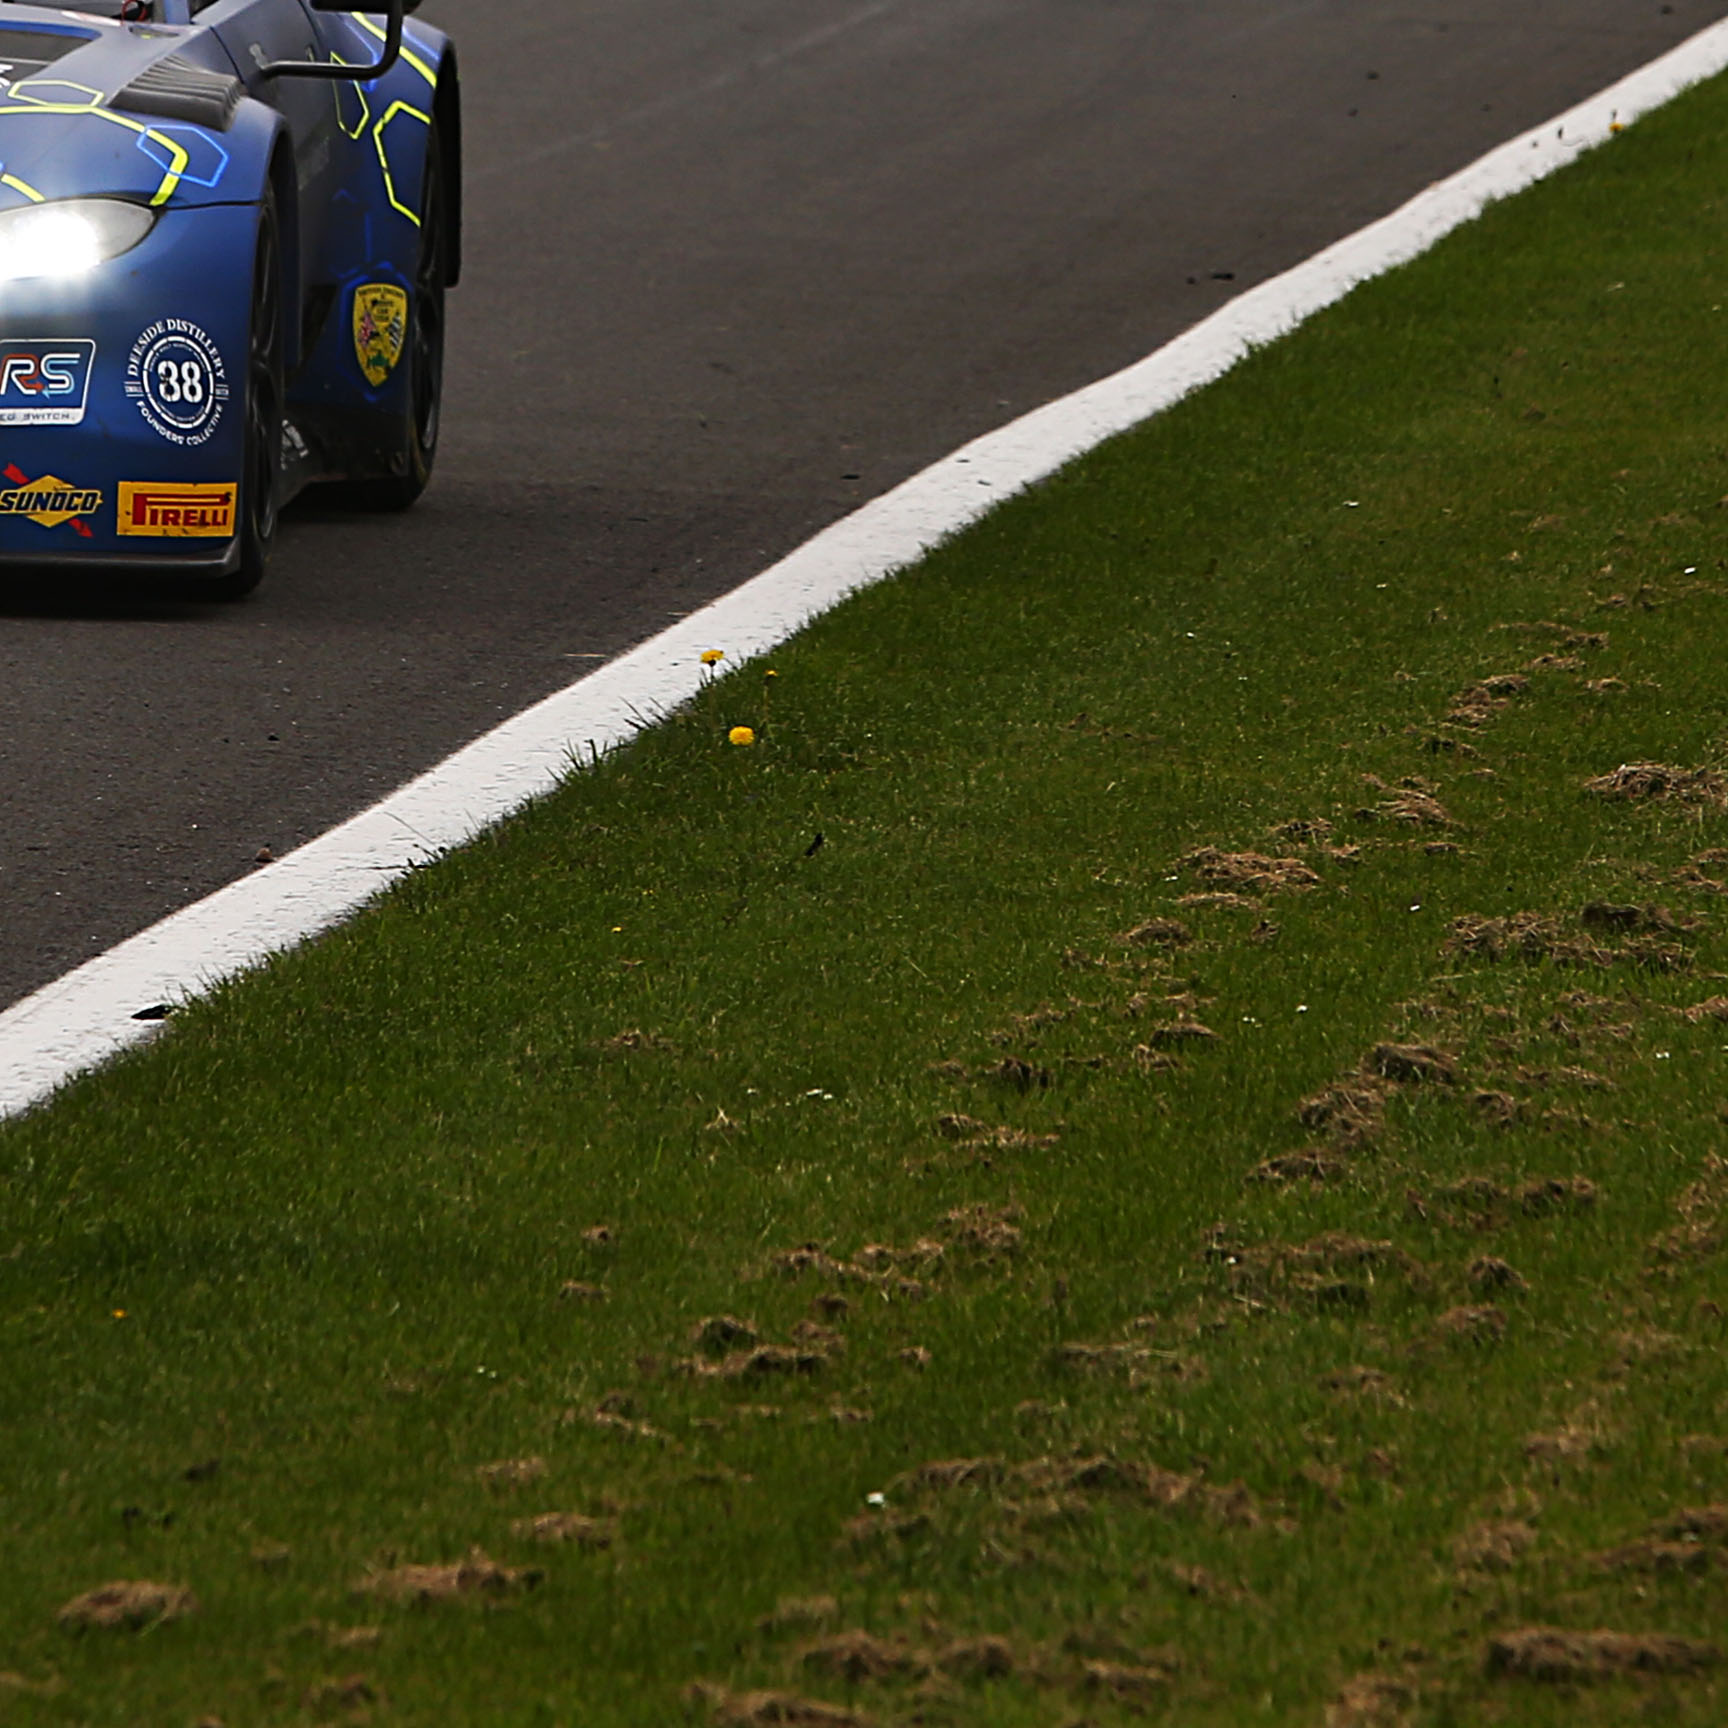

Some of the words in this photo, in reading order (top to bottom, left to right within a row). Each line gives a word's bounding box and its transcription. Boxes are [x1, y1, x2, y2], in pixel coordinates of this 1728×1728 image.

[127, 320, 166, 377] DEESIDE
[166, 318, 226, 380] DISTILLERY
[22, 412, 71, 421] SWITCH
[132, 491, 230, 527] PIRELLI
